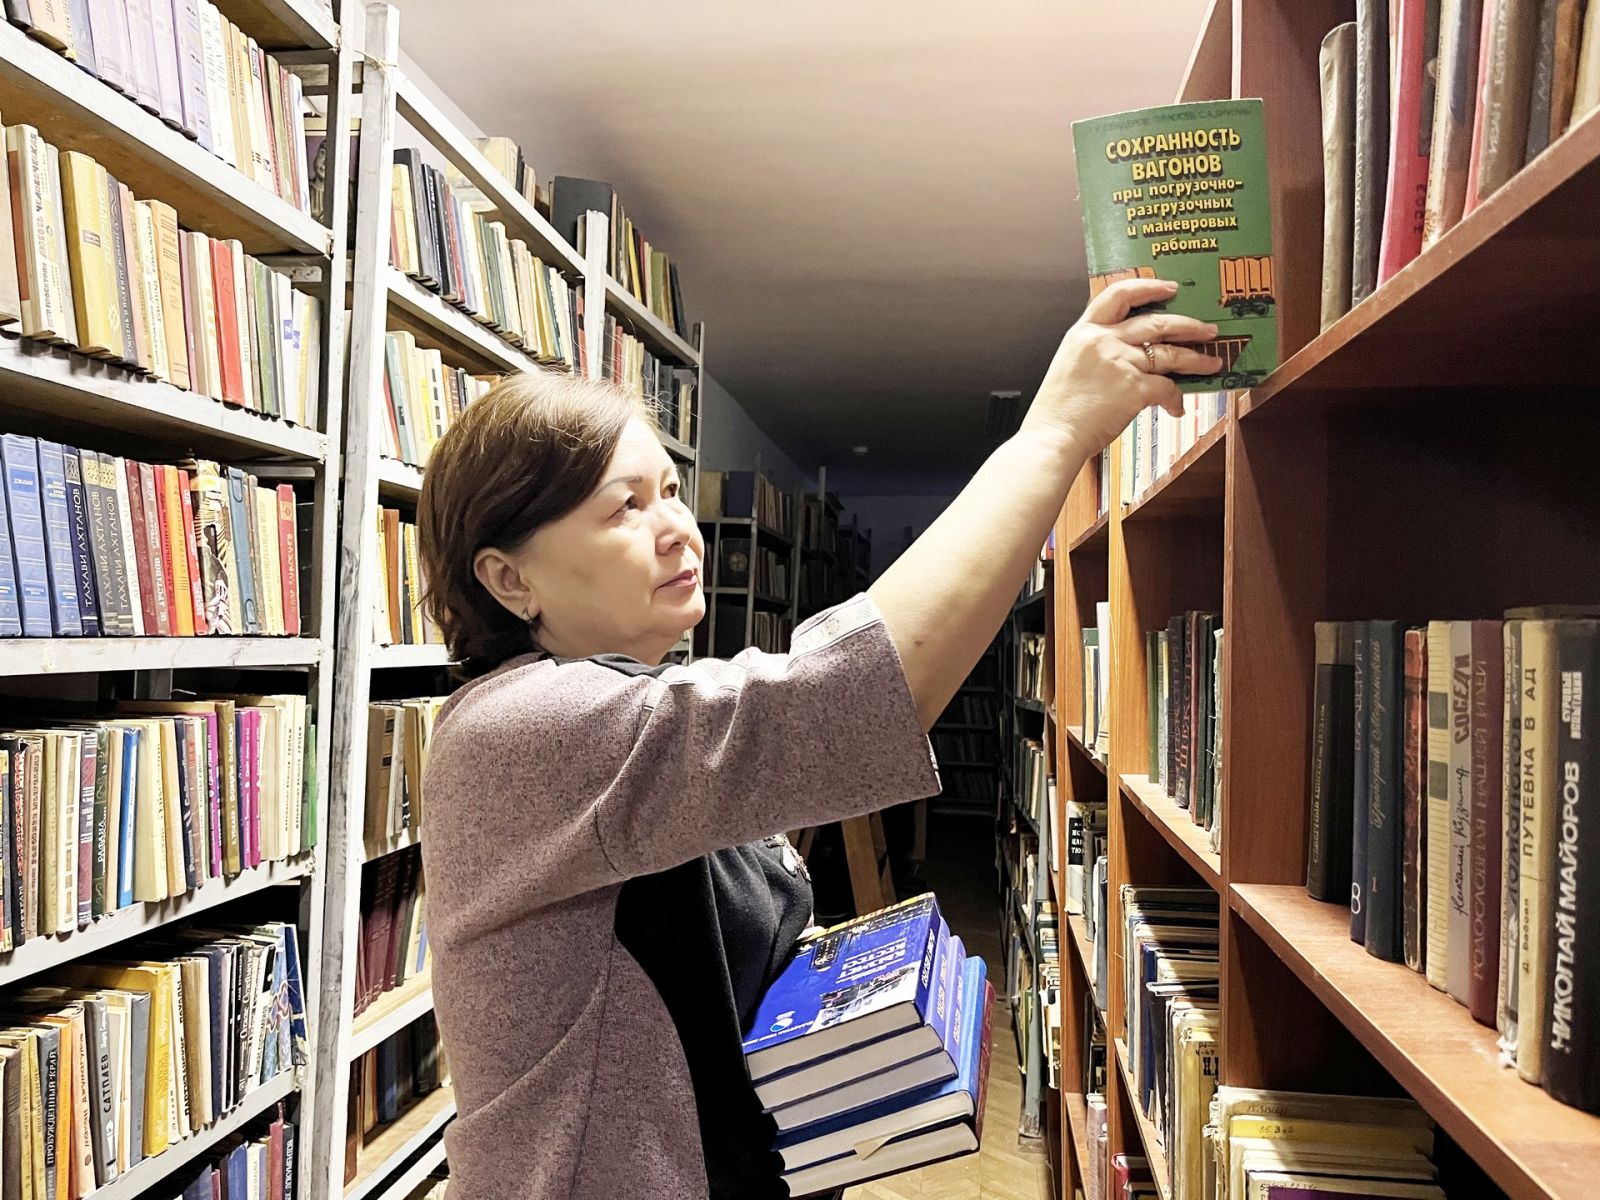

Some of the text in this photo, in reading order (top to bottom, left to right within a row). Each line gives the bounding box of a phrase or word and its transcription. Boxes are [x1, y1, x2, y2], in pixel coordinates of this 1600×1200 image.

[29, 132, 42, 212] ЧЕЛОВЕЧЕСКАЯ
[1105, 128, 1242, 159] СОХРАННОСТЬ
[1131, 154, 1223, 182] ВАГОНОВ
[1112, 179, 1242, 203] при погрузочно-
[1126, 197, 1233, 221] разгрузочных
[1126, 216, 1238, 239] и маневровых
[1150, 237, 1218, 256] работах
[73, 488, 93, 607] ТАХАВИ АХТАНОВ
[92, 491, 114, 607] ТАХАВИ АХТАНОВ
[107, 495, 129, 608] ТАХАВИ АХТАНОВ
[1180, 616, 1191, 770] ШЕКСПИР
[1453, 653, 1471, 744] СОСЕДИ
[1523, 667, 1536, 701] АД
[1523, 717, 1535, 731] В
[1473, 727, 1488, 808] НАШЕЙ
[1522, 746, 1537, 857] ПУТЕВКА
[1508, 714, 1522, 907] ЛОМОНОСОВ
[1350, 881, 1362, 915] 8
[1450, 844, 1469, 916] Николай
[1471, 817, 1487, 981] РОДОСЛОВНАЯ
[1551, 761, 1580, 1052] НИКОЛАЙ МАЙОРОВ
[47, 1050, 57, 1078] КРАЙ
[100, 1053, 111, 1113] САТПАЕВ
[46, 1080, 56, 1165] ПРОБУЖДЕННЫЙ
